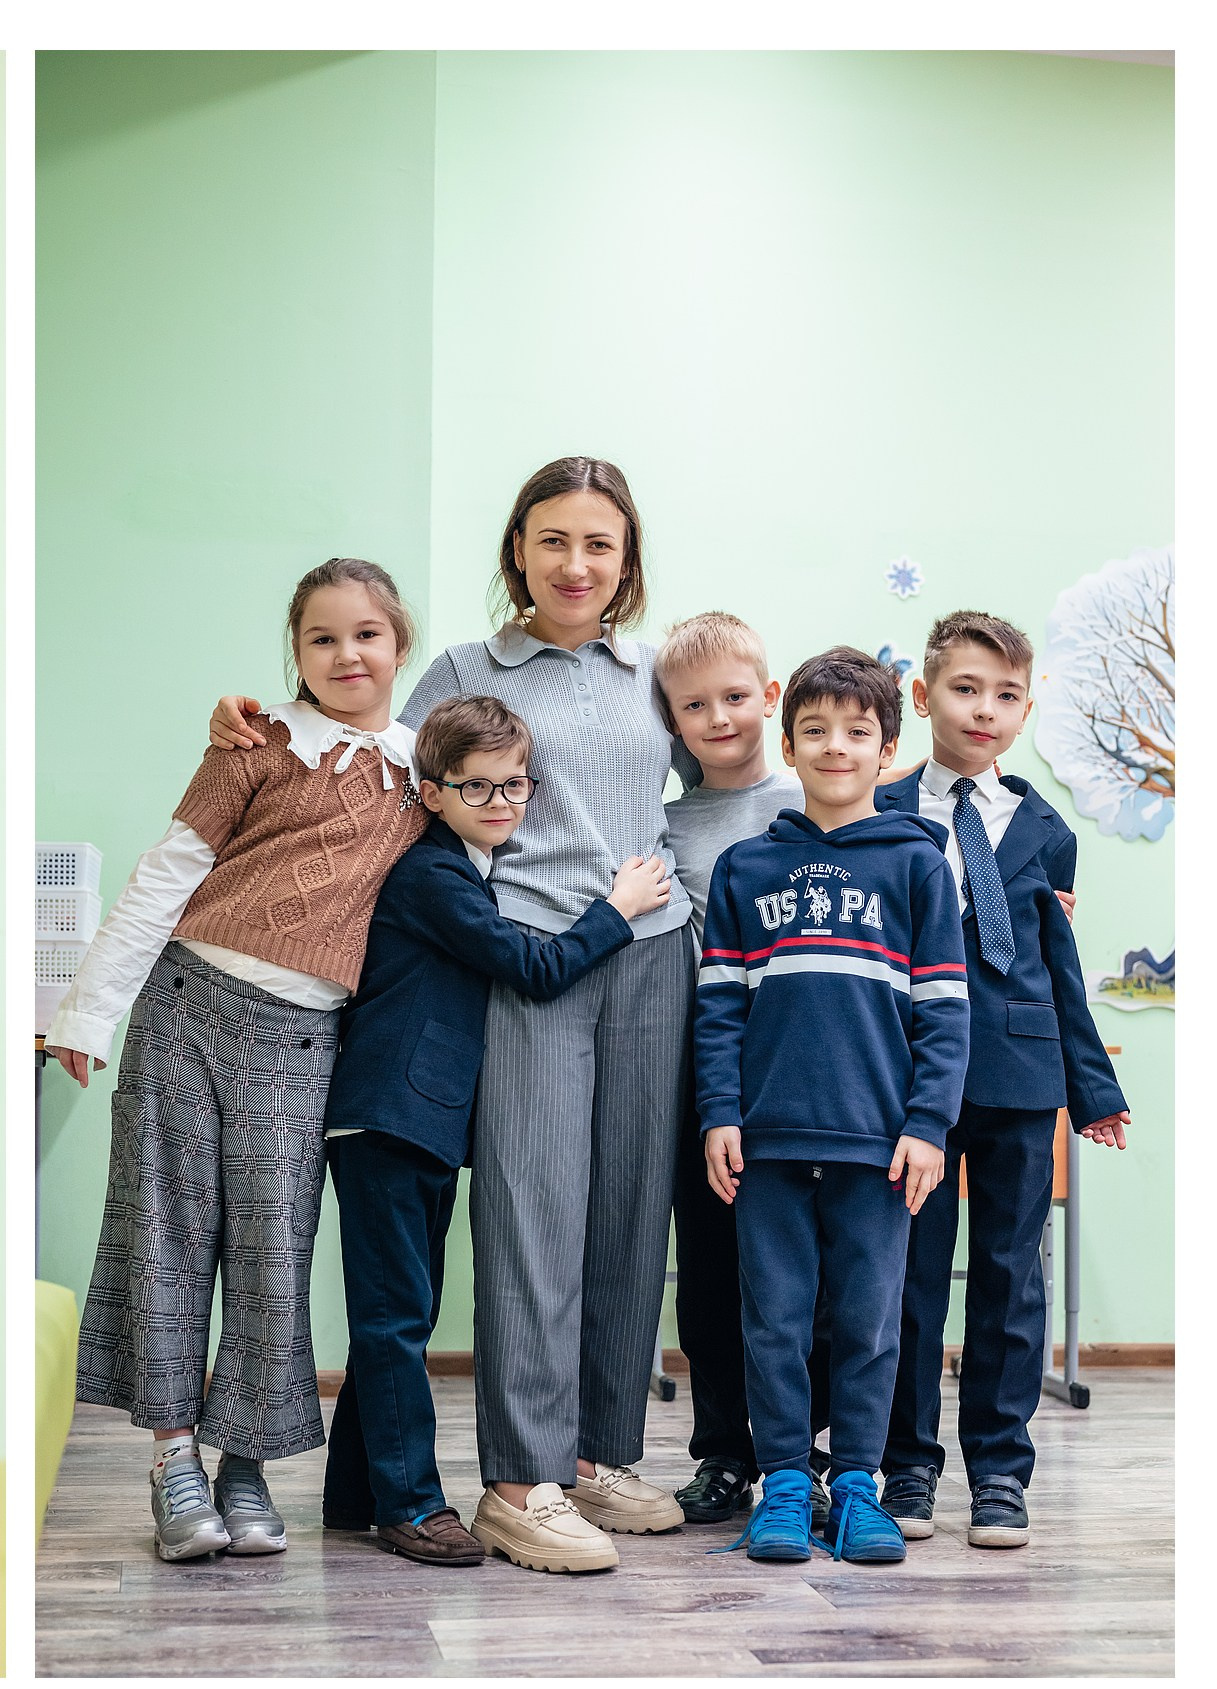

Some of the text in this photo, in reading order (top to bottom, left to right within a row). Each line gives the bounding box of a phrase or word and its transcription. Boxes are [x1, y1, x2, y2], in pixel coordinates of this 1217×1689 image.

[788, 863, 852, 883] AUTHENTIC
[755, 887, 884, 931] US PA
